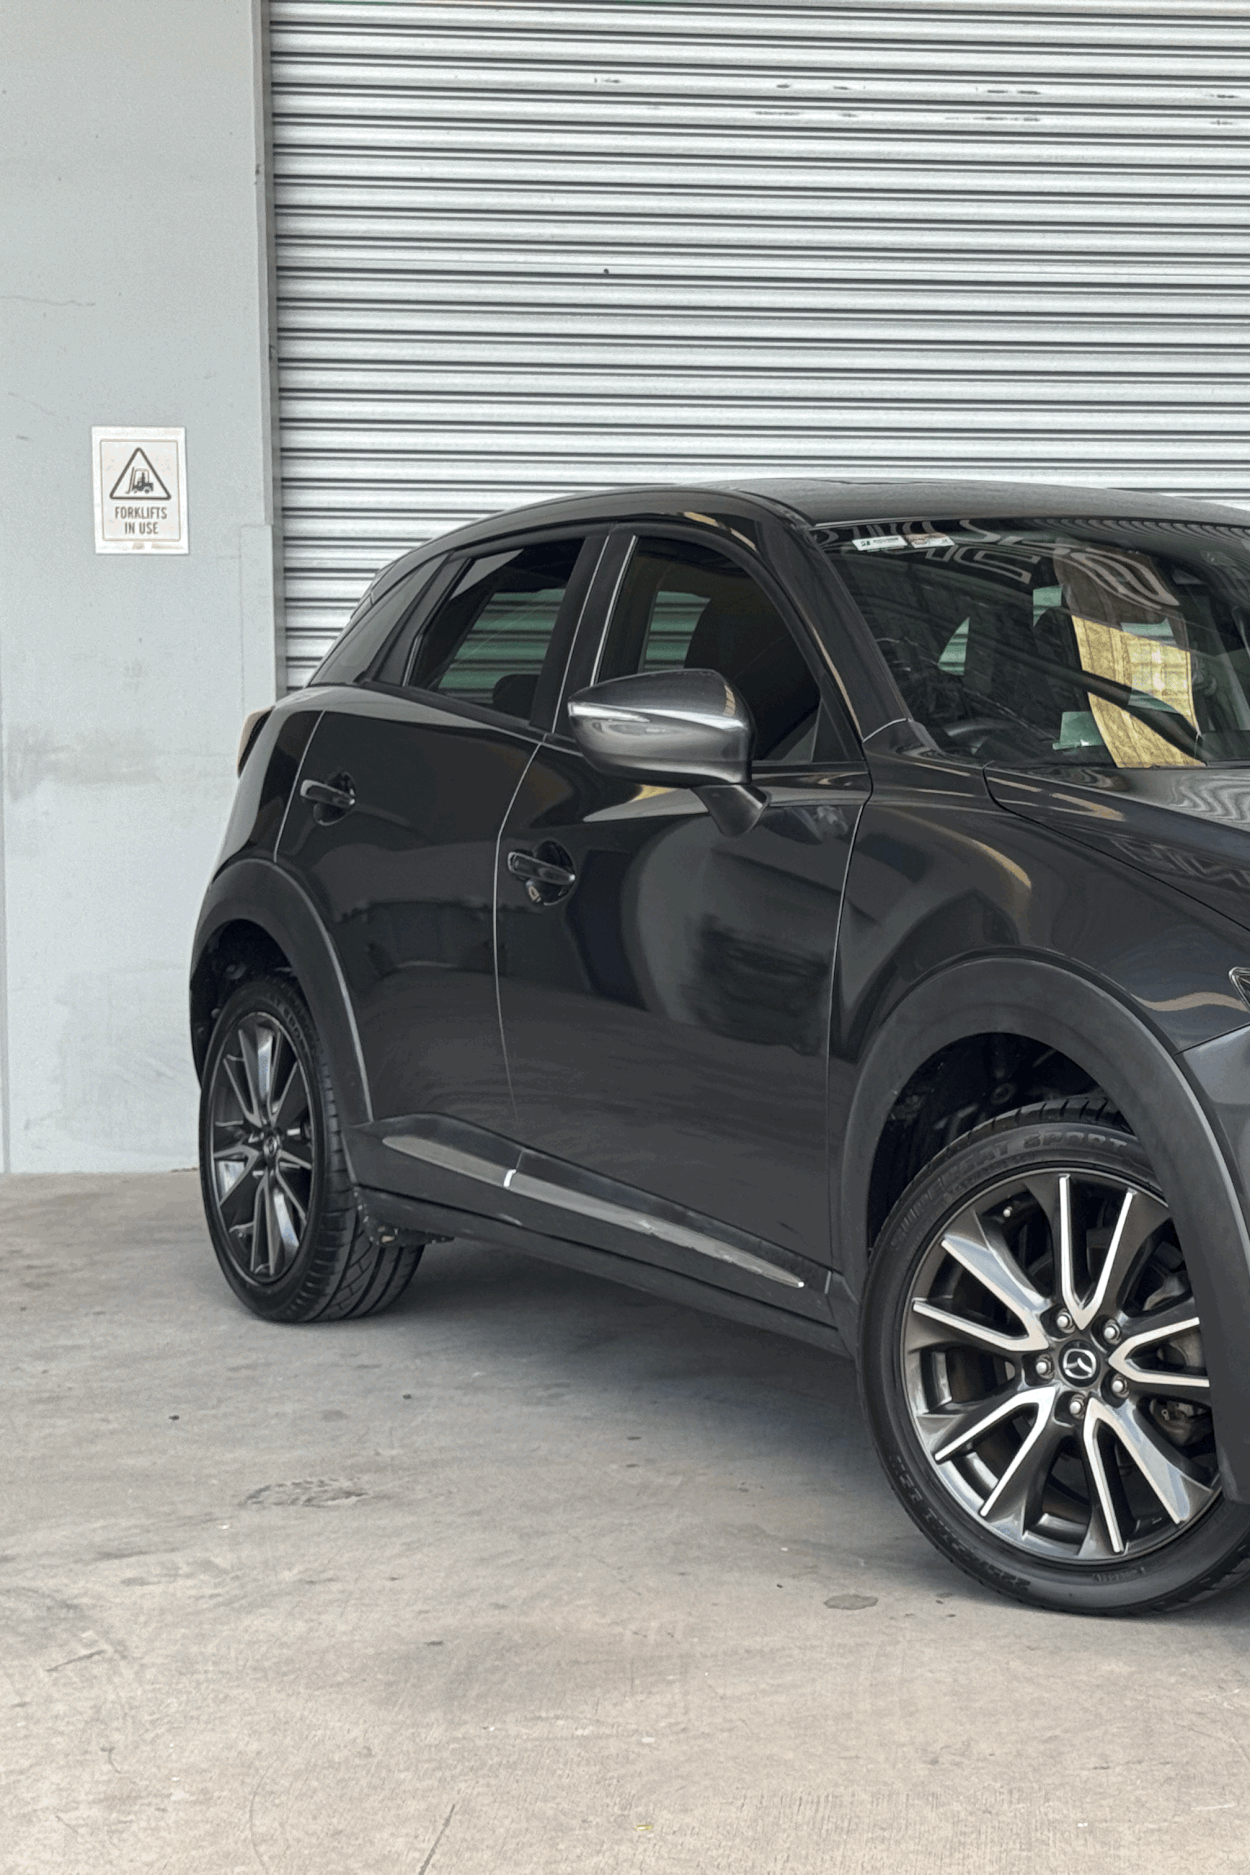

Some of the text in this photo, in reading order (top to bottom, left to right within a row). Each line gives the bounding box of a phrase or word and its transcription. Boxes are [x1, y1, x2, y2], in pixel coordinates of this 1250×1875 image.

[115, 506, 168, 519] FORKLIFTS
[124, 522, 158, 534] IN USE
